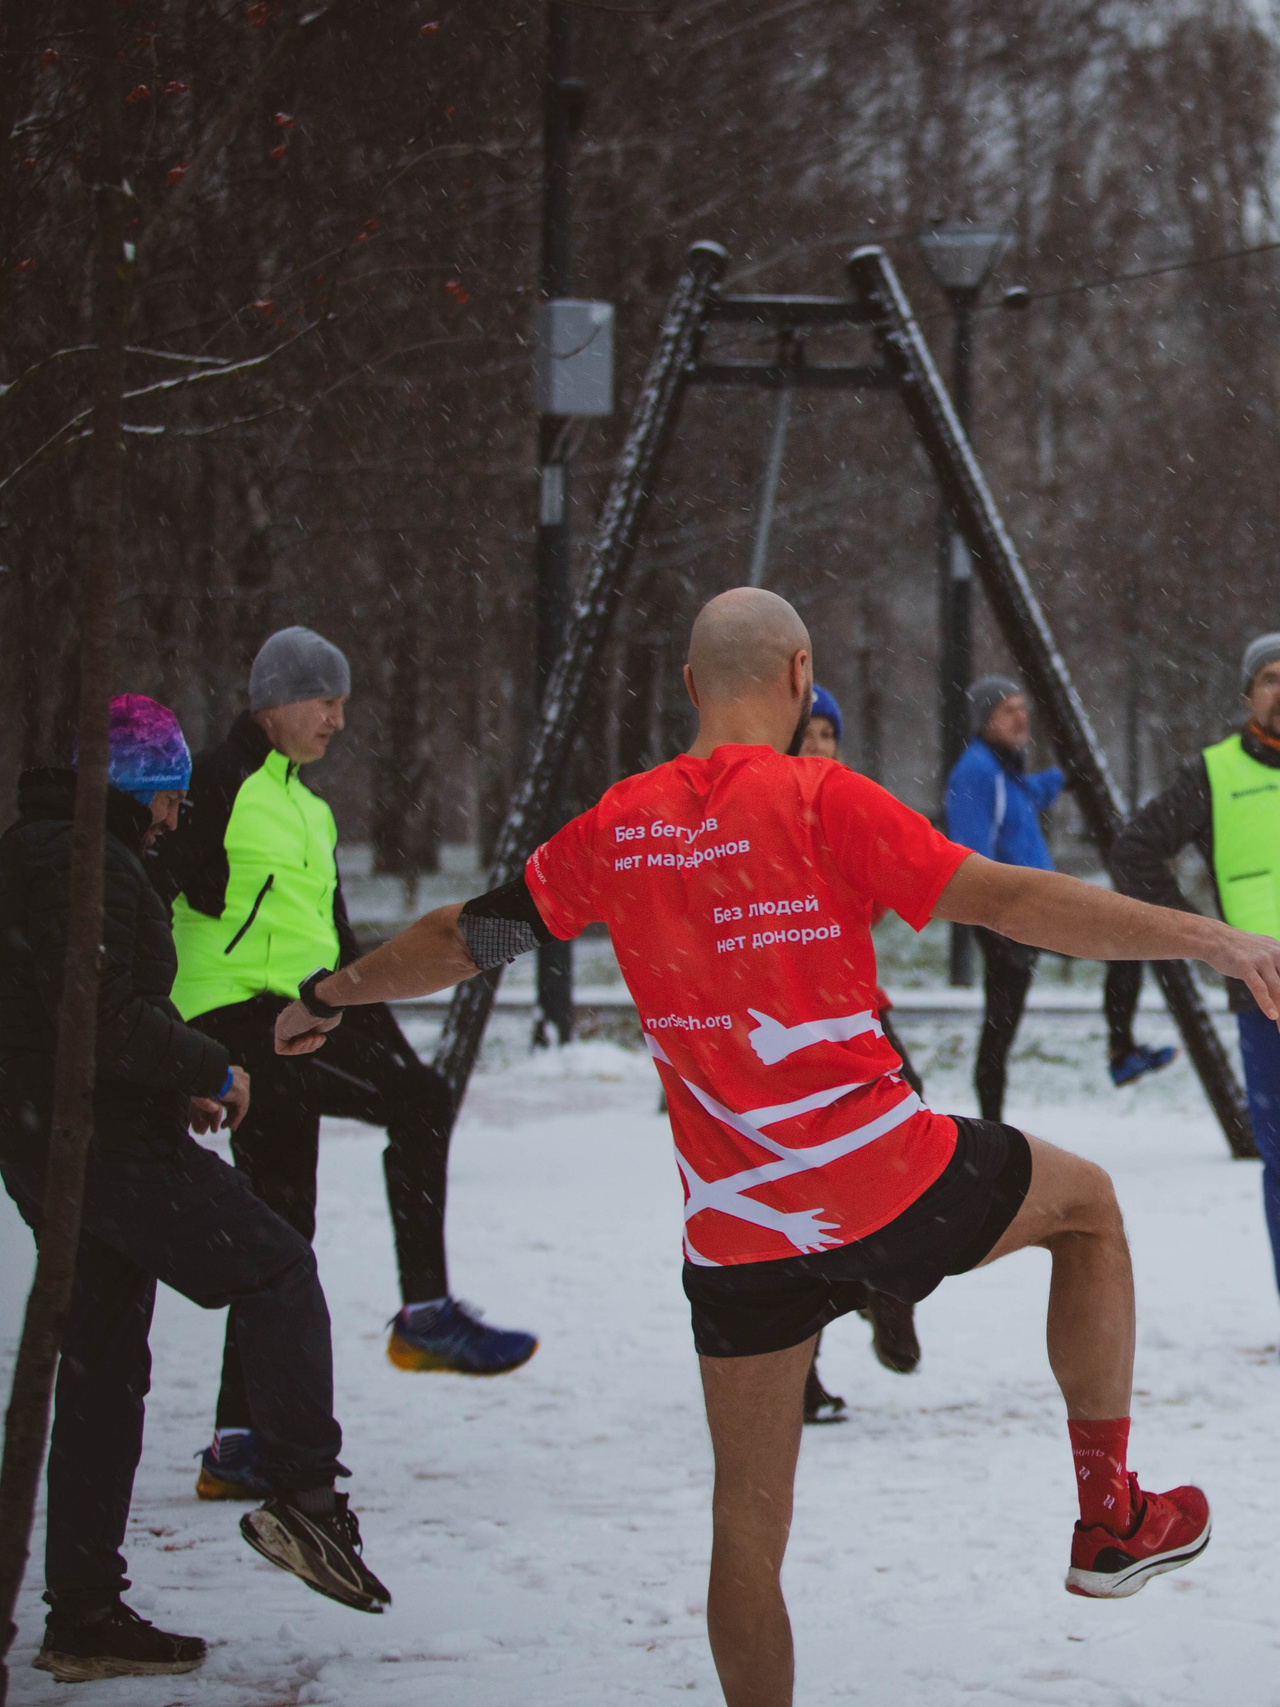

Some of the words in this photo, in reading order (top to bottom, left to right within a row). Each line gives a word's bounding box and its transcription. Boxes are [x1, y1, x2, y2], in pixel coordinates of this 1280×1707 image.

[615, 825, 645, 842] Без
[651, 818, 718, 844] бегув
[614, 854, 642, 871] нет
[713, 906, 742, 924] Без
[748, 895, 819, 918] людей
[717, 936, 746, 954] нет
[752, 924, 841, 949] доноров
